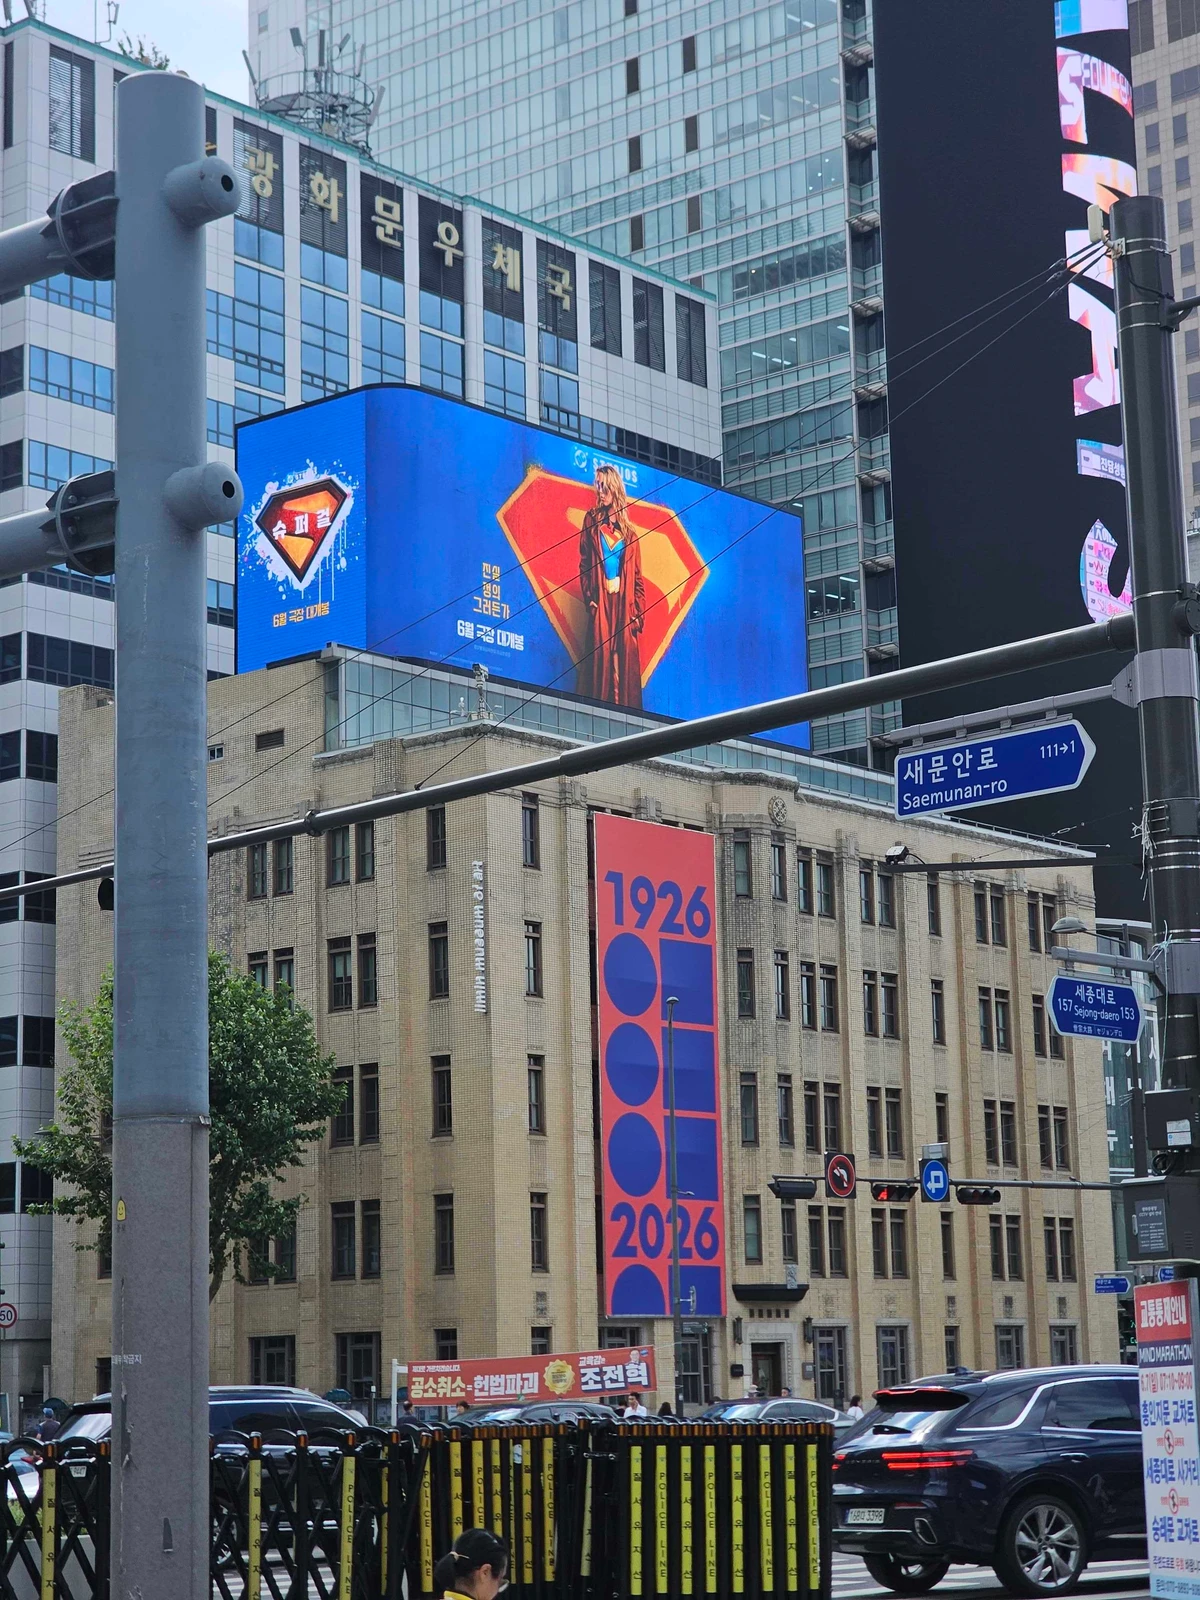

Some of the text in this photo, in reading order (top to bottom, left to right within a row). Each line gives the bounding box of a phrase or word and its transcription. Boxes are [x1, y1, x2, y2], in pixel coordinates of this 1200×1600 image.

[271, 506, 331, 541] 슈퍼걸
[482, 561, 501, 582] 진실
[272, 601, 330, 629] 6월 극장 대개봉
[472, 595, 510, 620] 그러든가
[456, 619, 475, 639] 6월
[476, 624, 496, 644] 극장
[496, 628, 525, 651] 대개봉
[903, 746, 999, 786] 새문안로
[903, 779, 1008, 810] Saemunan-ro
[604, 869, 712, 939] 1926
[1074, 983, 1117, 1005] 세종대로
[1057, 998, 1135, 1022] 157 Sejong-daero 153
[610, 1200, 721, 1263] 2026
[0, 1309, 13, 1322] 50
[1140, 1295, 1188, 1329] 교통통제안내
[1139, 1343, 1193, 1364] MIND MARATHON
[579, 1362, 650, 1391] 조전혁
[1142, 1399, 1195, 1427] 흥인지문 교차로
[1146, 1457, 1200, 1486] 세종대로 사거리
[659, 1472, 667, 1529] POLICE
[707, 1472, 716, 1577] POLICE LINE
[763, 1471, 773, 1576] POLICE LINE
[1177, 1516, 1200, 1545] 교차로
[345, 1484, 355, 1594] POLICE LINE
